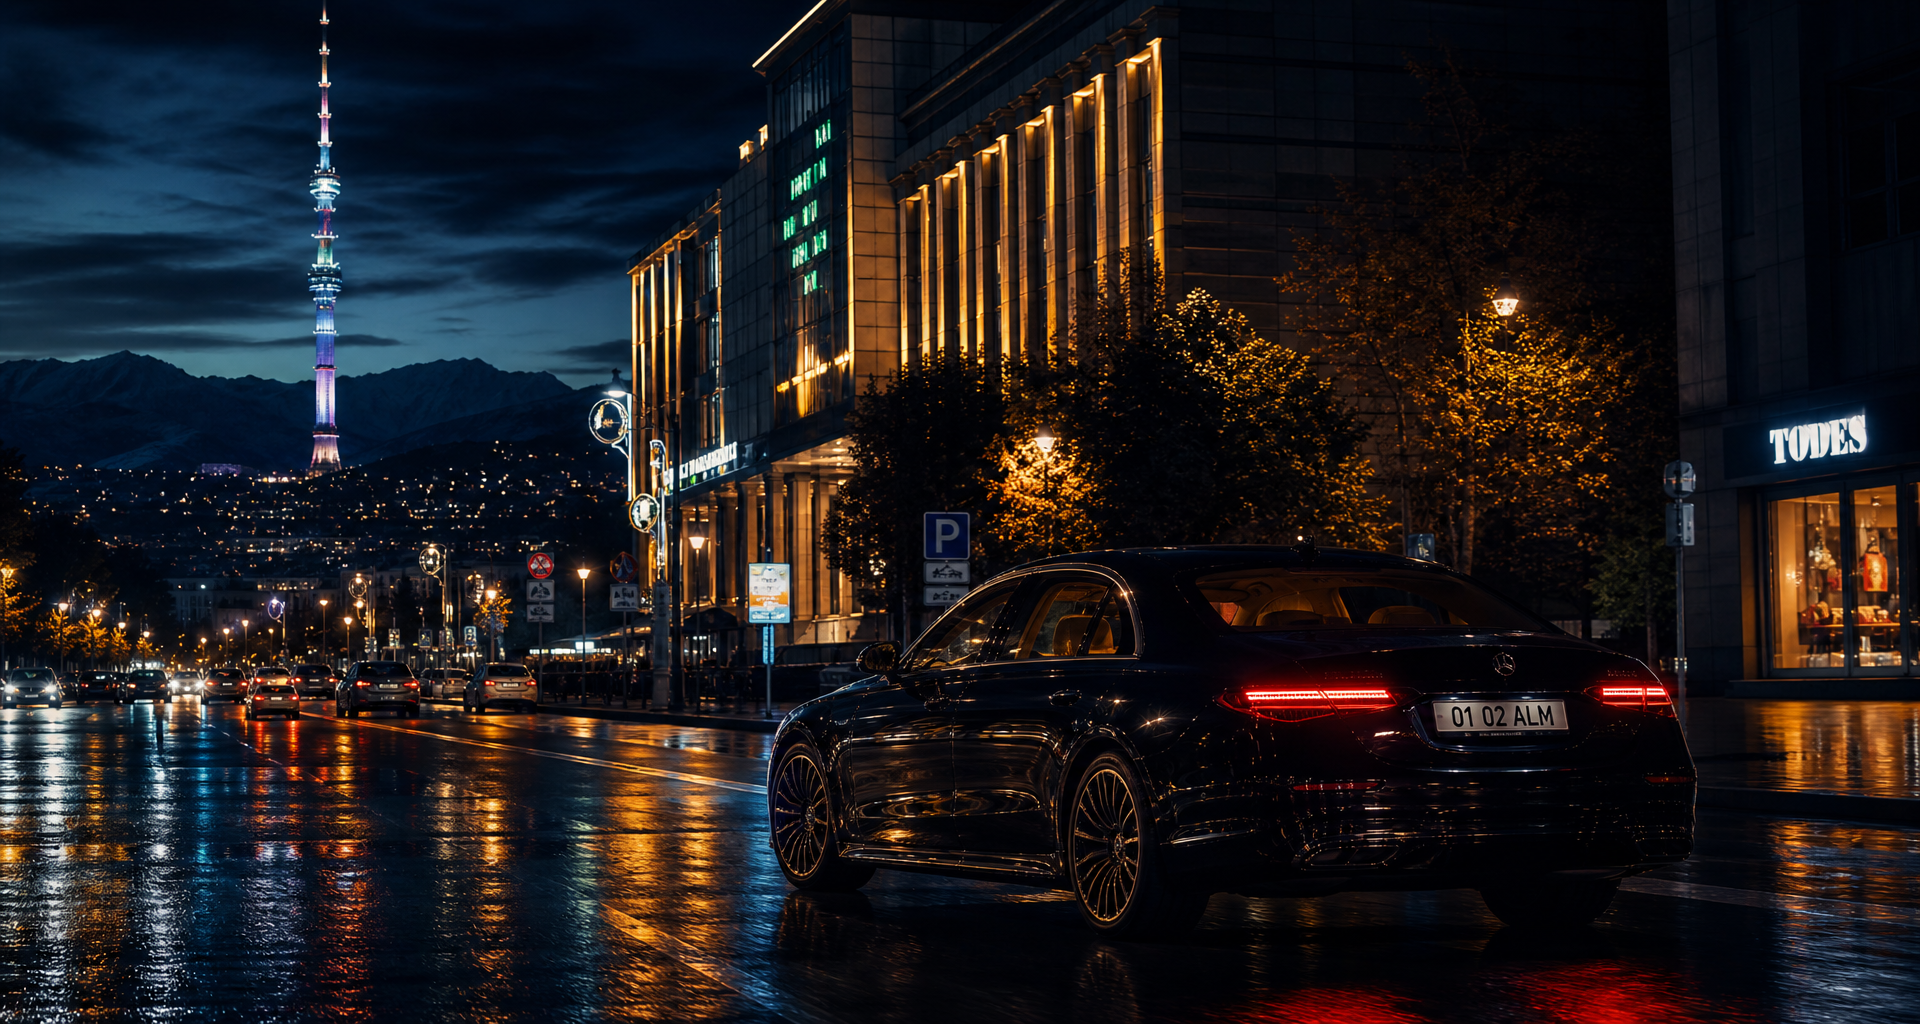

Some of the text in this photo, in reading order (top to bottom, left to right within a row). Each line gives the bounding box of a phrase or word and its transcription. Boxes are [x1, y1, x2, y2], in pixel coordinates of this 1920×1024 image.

[1769, 414, 1867, 464] TODES
[936, 518, 960, 553] P
[1451, 705, 1555, 727] 01 02 ALM
